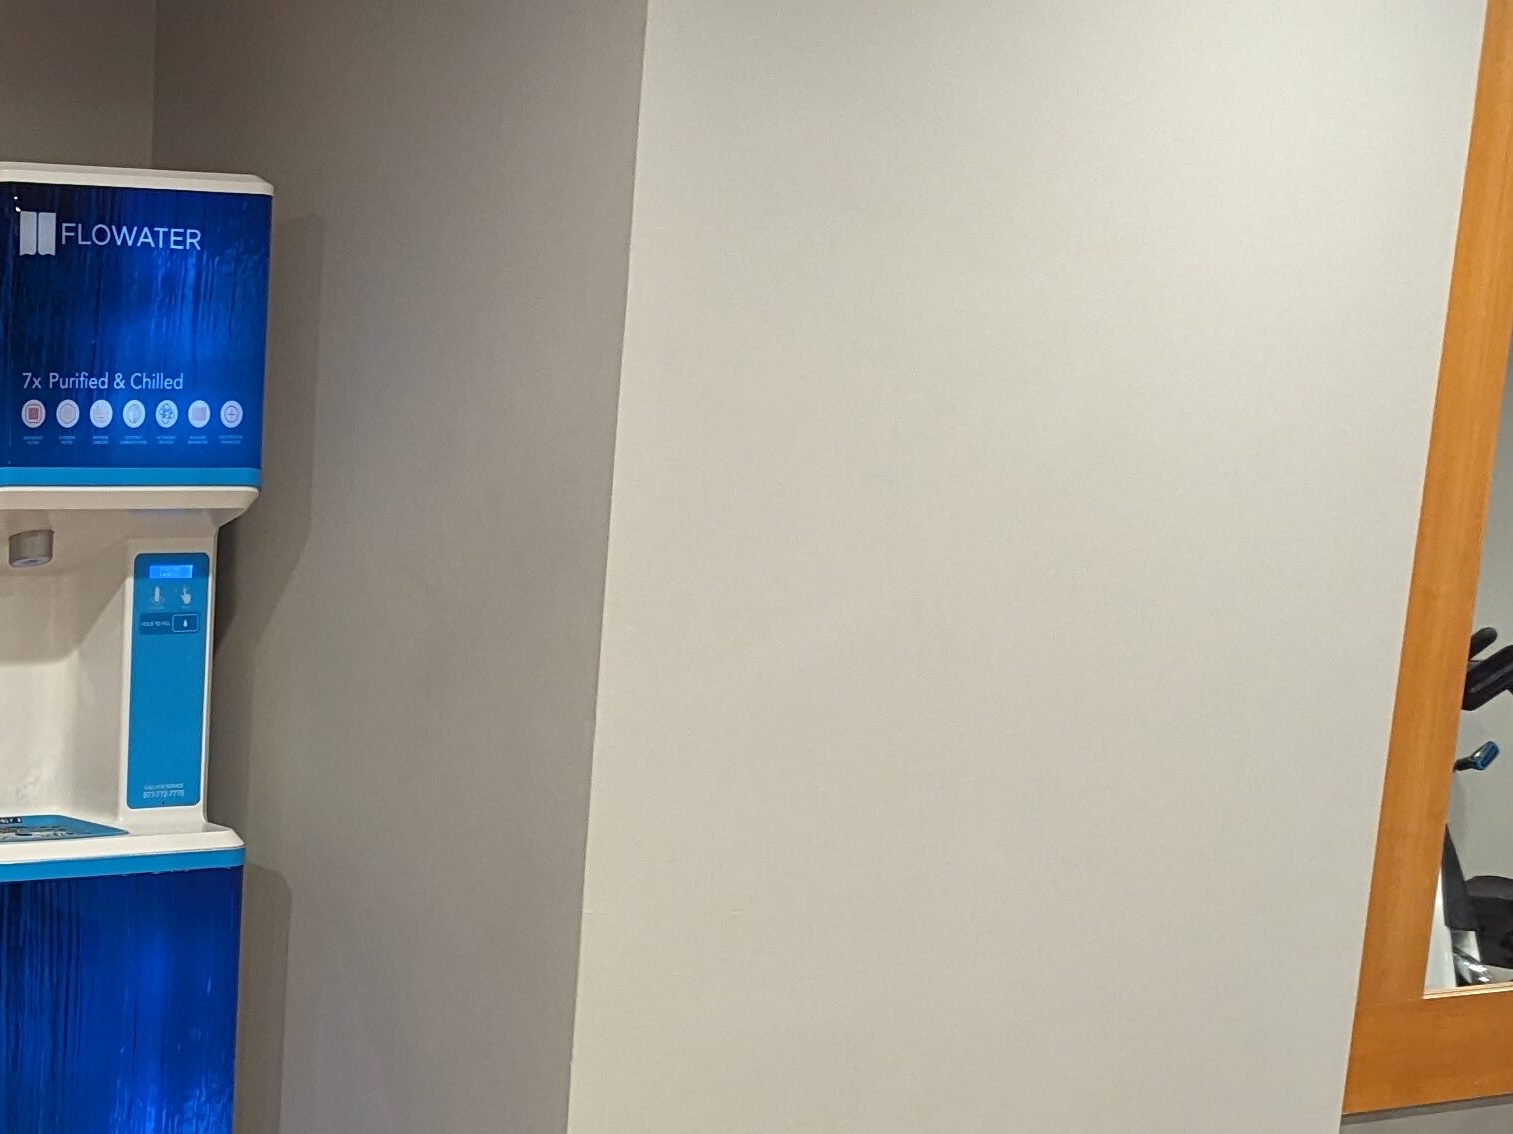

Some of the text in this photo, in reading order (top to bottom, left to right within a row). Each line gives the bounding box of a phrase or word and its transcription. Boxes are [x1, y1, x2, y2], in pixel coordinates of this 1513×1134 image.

[61, 222, 202, 250] FLOWATER
[22, 371, 184, 389] 7x Purified & Chilled
